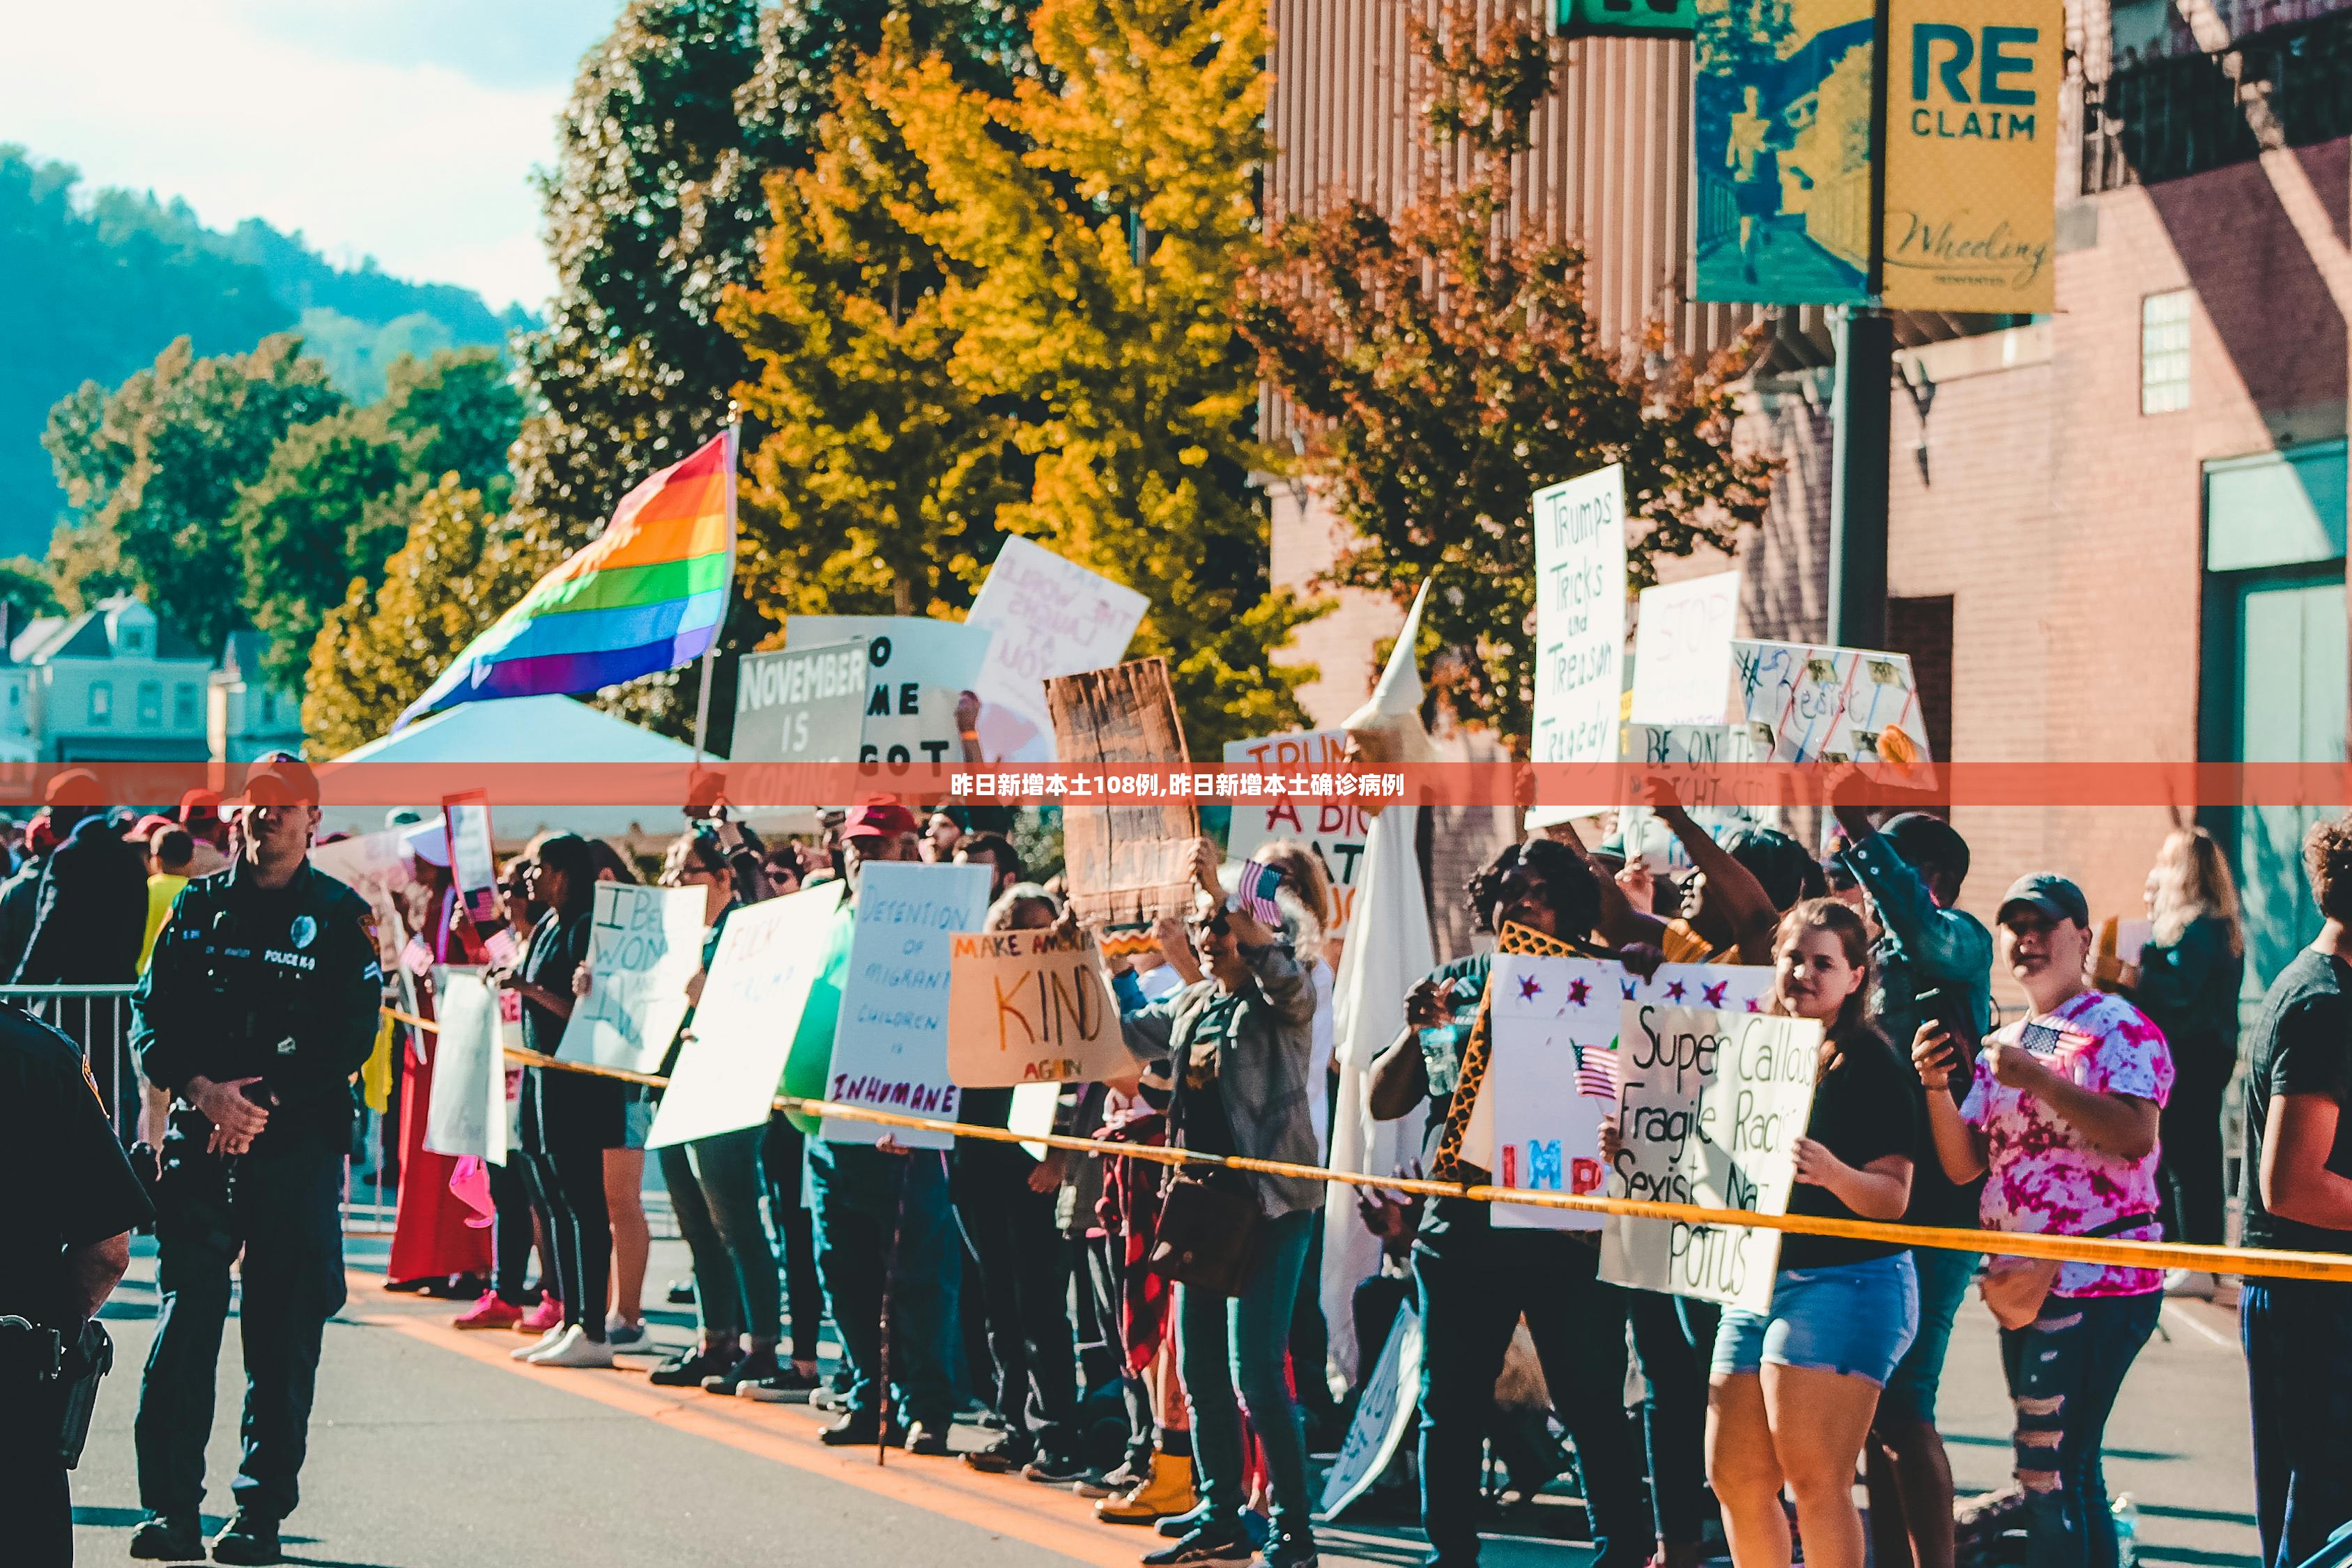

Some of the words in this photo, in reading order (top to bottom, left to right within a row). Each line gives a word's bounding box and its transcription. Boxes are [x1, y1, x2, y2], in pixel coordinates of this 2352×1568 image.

[1911, 22, 2039, 106] RE
[1911, 109, 2036, 141] CLAIM
[1884, 208, 2050, 292] Wheeling
[1656, 593, 1728, 662] STOP
[739, 649, 866, 713] NOVEMBER
[781, 711, 809, 753] IS
[1645, 725, 1672, 770] BE
[1686, 730, 1719, 774] ON
[597, 886, 633, 930] I
[861, 883, 971, 931] DETENTION
[263, 948, 298, 967] POLICE
[954, 934, 1022, 958] MAKE
[857, 1003, 938, 1031] CHILDREN
[994, 964, 1102, 1051] KIND
[1633, 1006, 1732, 1094] Super
[833, 1073, 958, 1113] INHUMANE
[1617, 1082, 1717, 1164] Fragile
[1607, 1148, 1698, 1205] Sexist
[1668, 1221, 1753, 1297] POTUS
